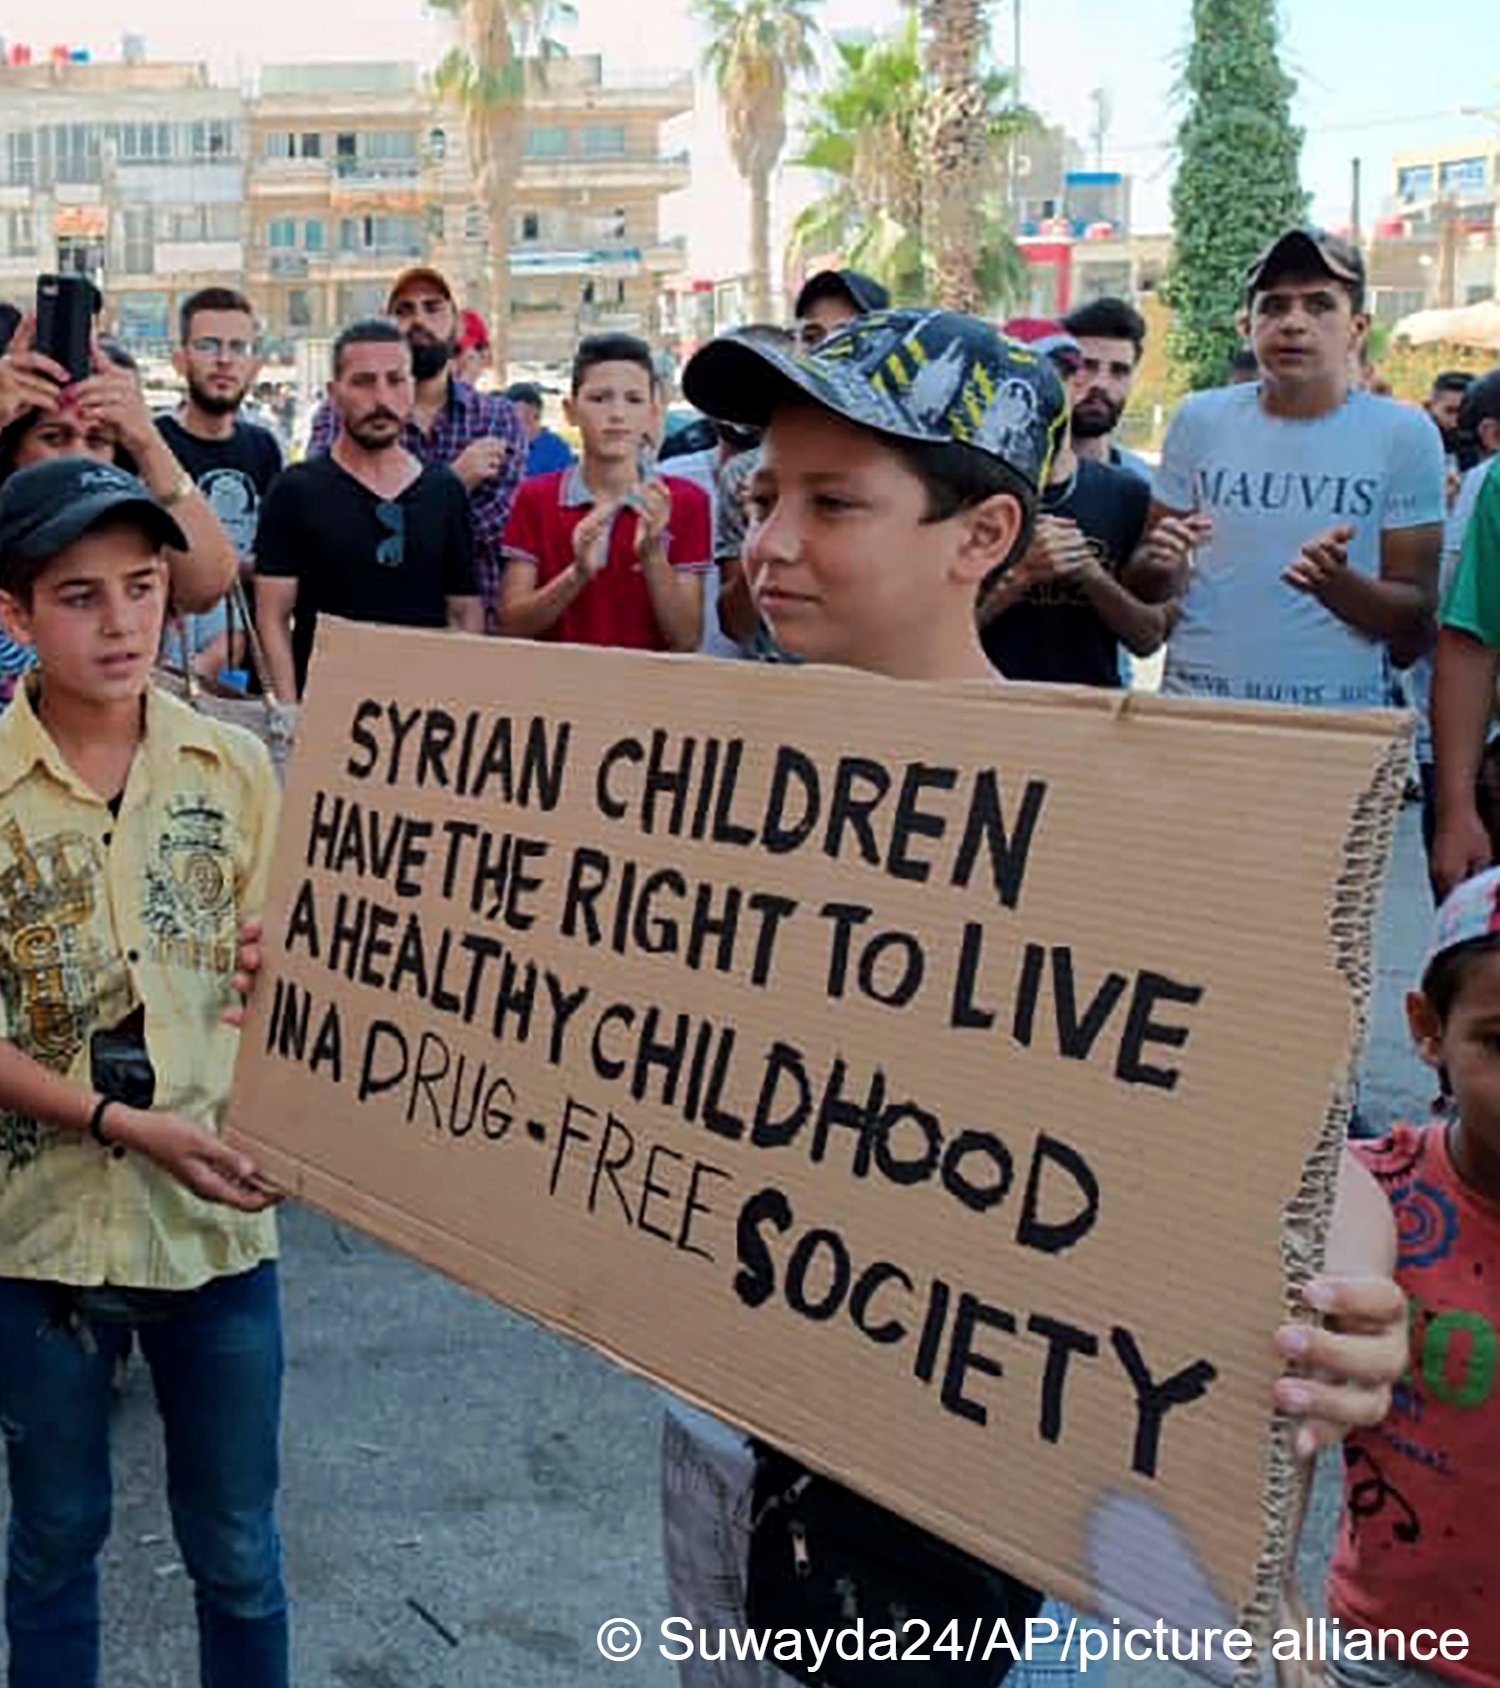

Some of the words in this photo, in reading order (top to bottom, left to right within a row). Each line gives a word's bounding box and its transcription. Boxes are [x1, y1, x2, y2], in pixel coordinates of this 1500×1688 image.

[1196, 470, 1378, 515] MAUVIS
[307, 792, 433, 897] HAVE
[442, 820, 546, 929] THE
[560, 848, 795, 987] RIGHT
[822, 905, 924, 1005] TO
[952, 924, 1203, 1089] LIVE
[347, 700, 570, 812] SYRIAN
[596, 730, 1046, 906] CHILDREN
[286, 881, 320, 959] A
[328, 896, 587, 1063] HEALTHY
[591, 1005, 1099, 1253] CHILDHOOD
[269, 978, 311, 1060] IN
[310, 1004, 342, 1083] A
[735, 1189, 1216, 1475] SOCIETY
